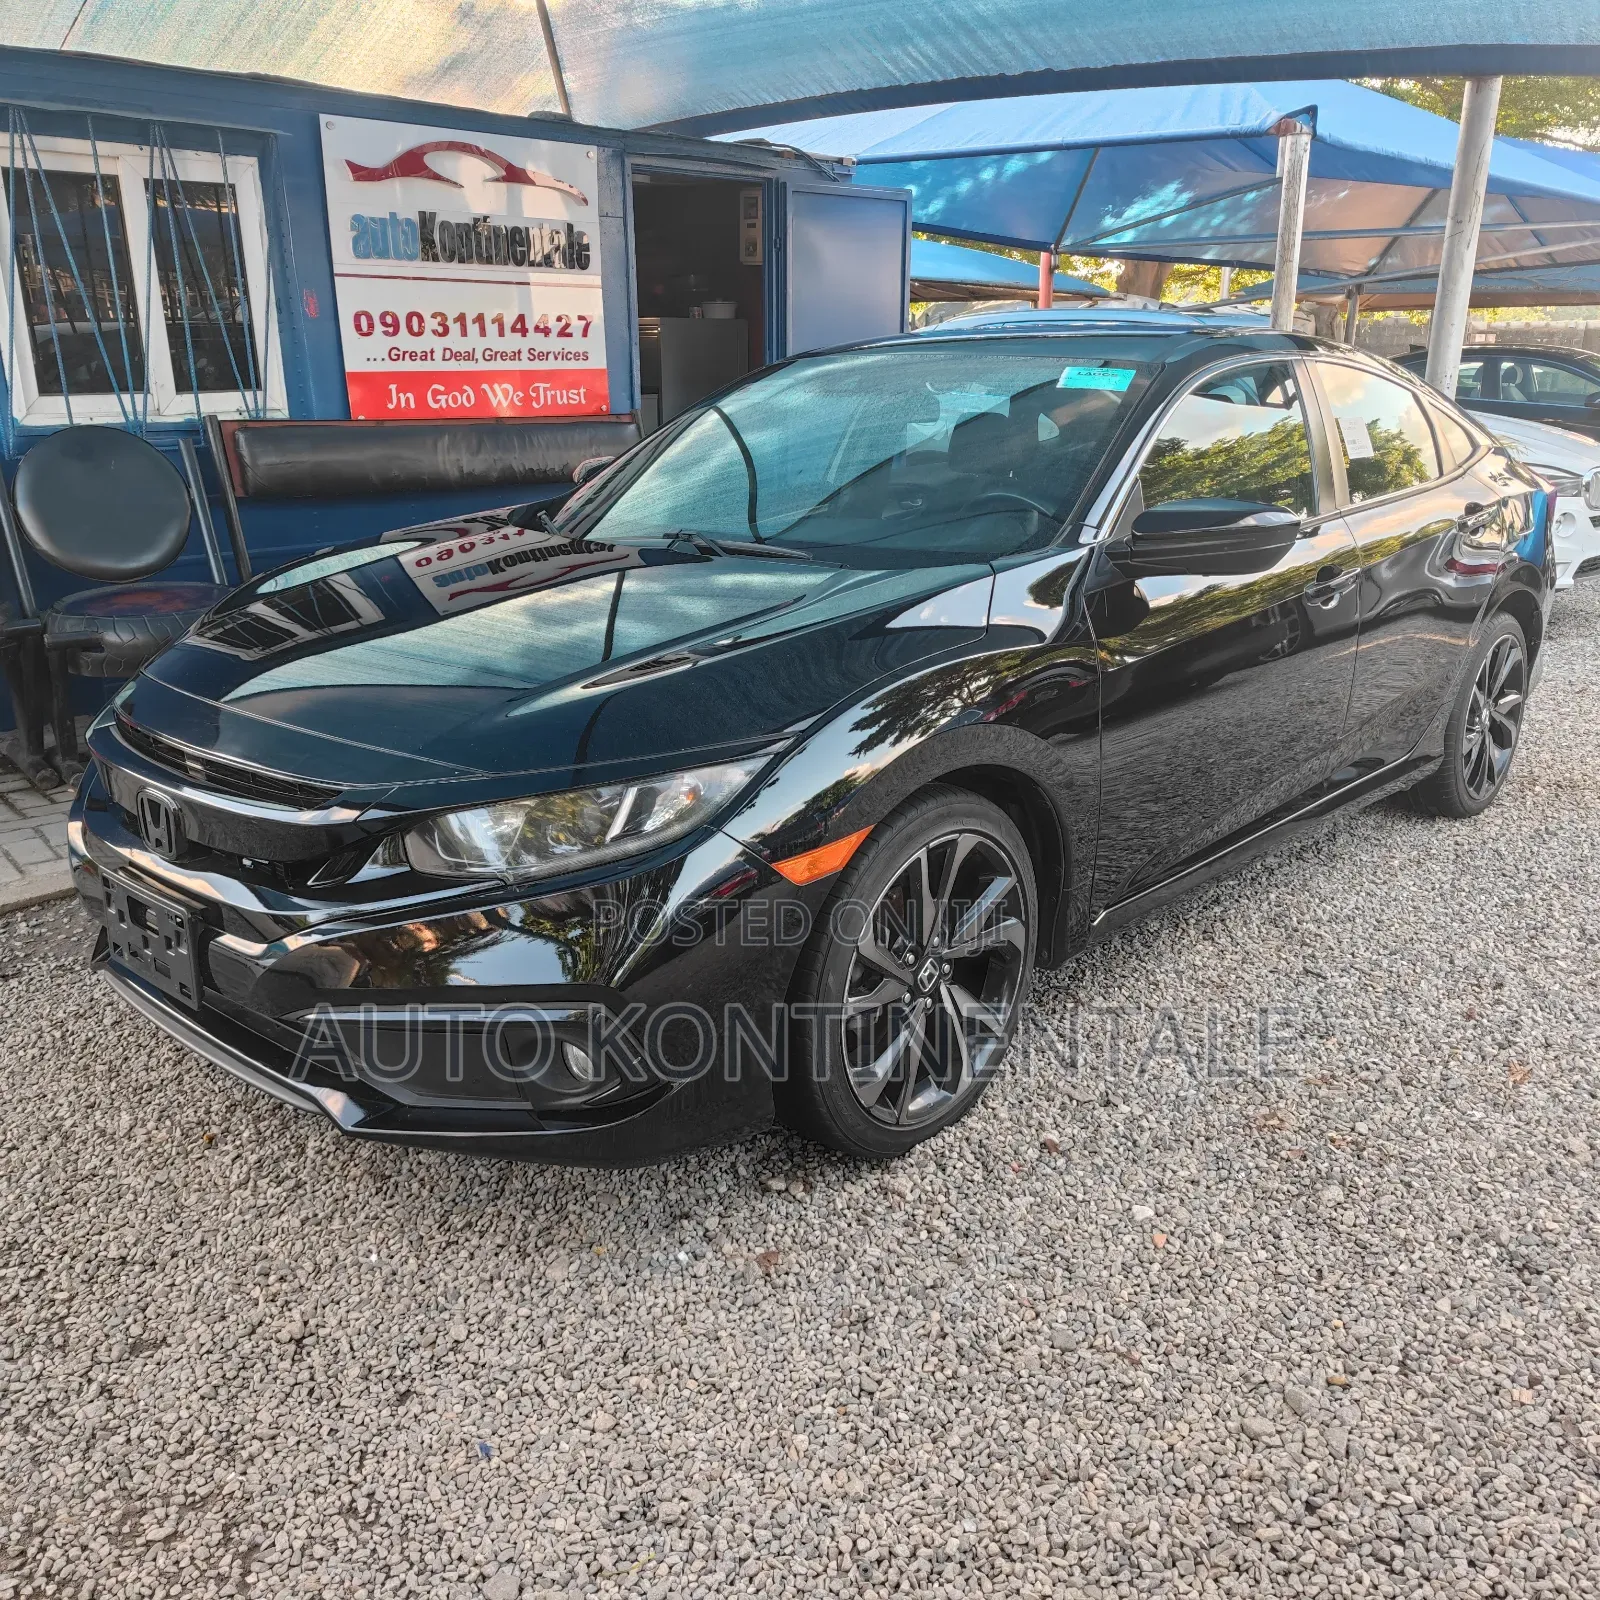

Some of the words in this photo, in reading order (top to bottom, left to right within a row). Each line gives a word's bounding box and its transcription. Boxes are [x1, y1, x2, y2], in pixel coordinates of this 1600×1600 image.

[353, 310, 593, 338] 09031114427
[482, 348, 522, 362] Great
[527, 347, 589, 362] Services
[427, 384, 475, 409] God
[481, 383, 525, 408] We
[529, 382, 587, 409] Trust
